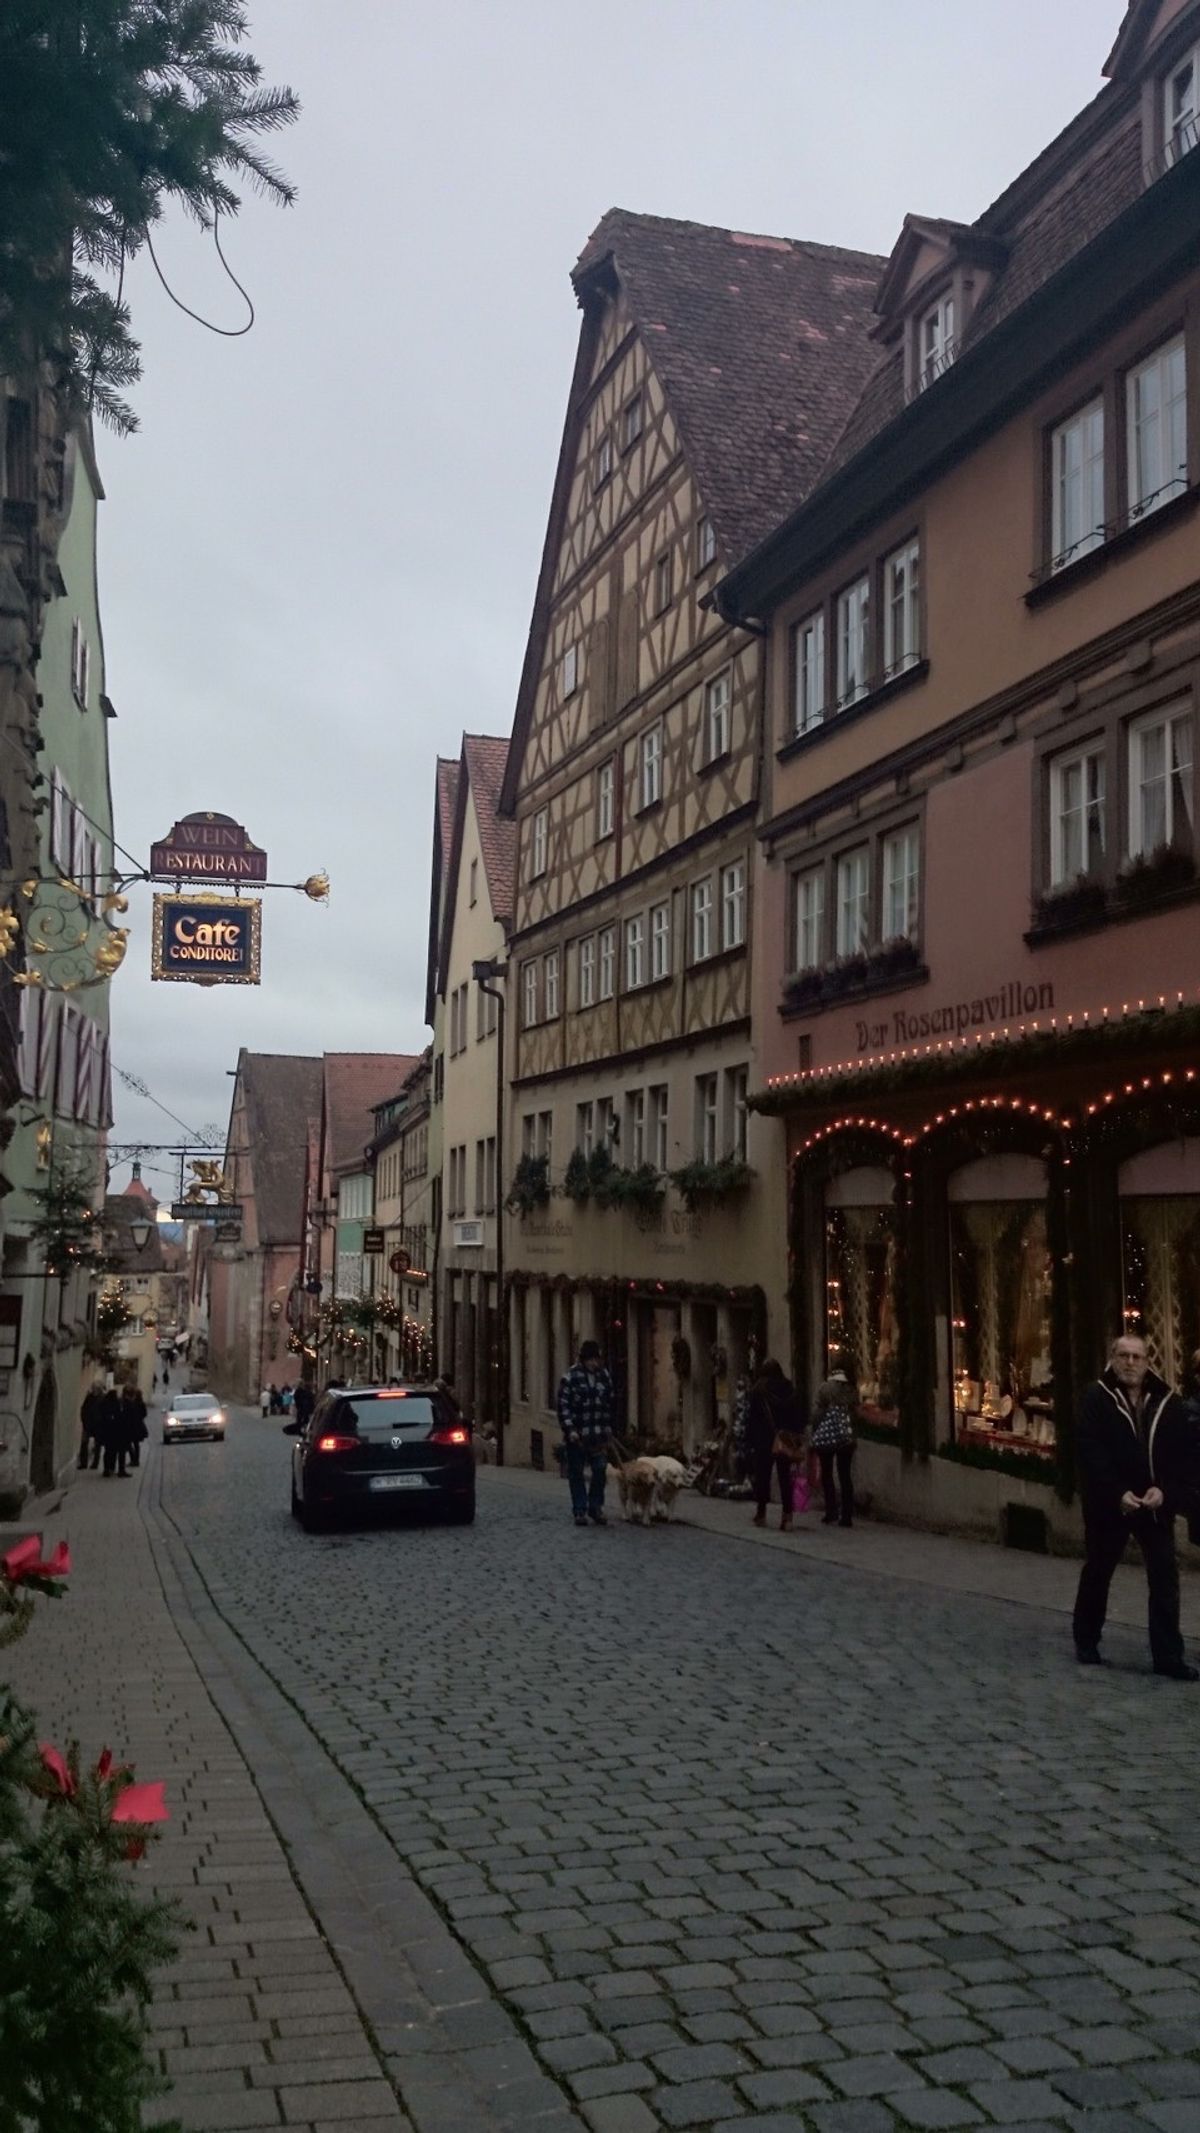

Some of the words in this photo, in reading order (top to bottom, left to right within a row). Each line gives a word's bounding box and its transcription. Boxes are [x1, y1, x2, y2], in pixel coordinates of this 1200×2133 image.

[182, 827, 239, 845] WEIN
[155, 852, 265, 873] RESTAURANT
[174, 917, 240, 945] Cafe
[170, 946, 244, 963] CONDITOREI
[856, 1020, 889, 1052] Der
[892, 981, 1055, 1043] Rosenpavillon
